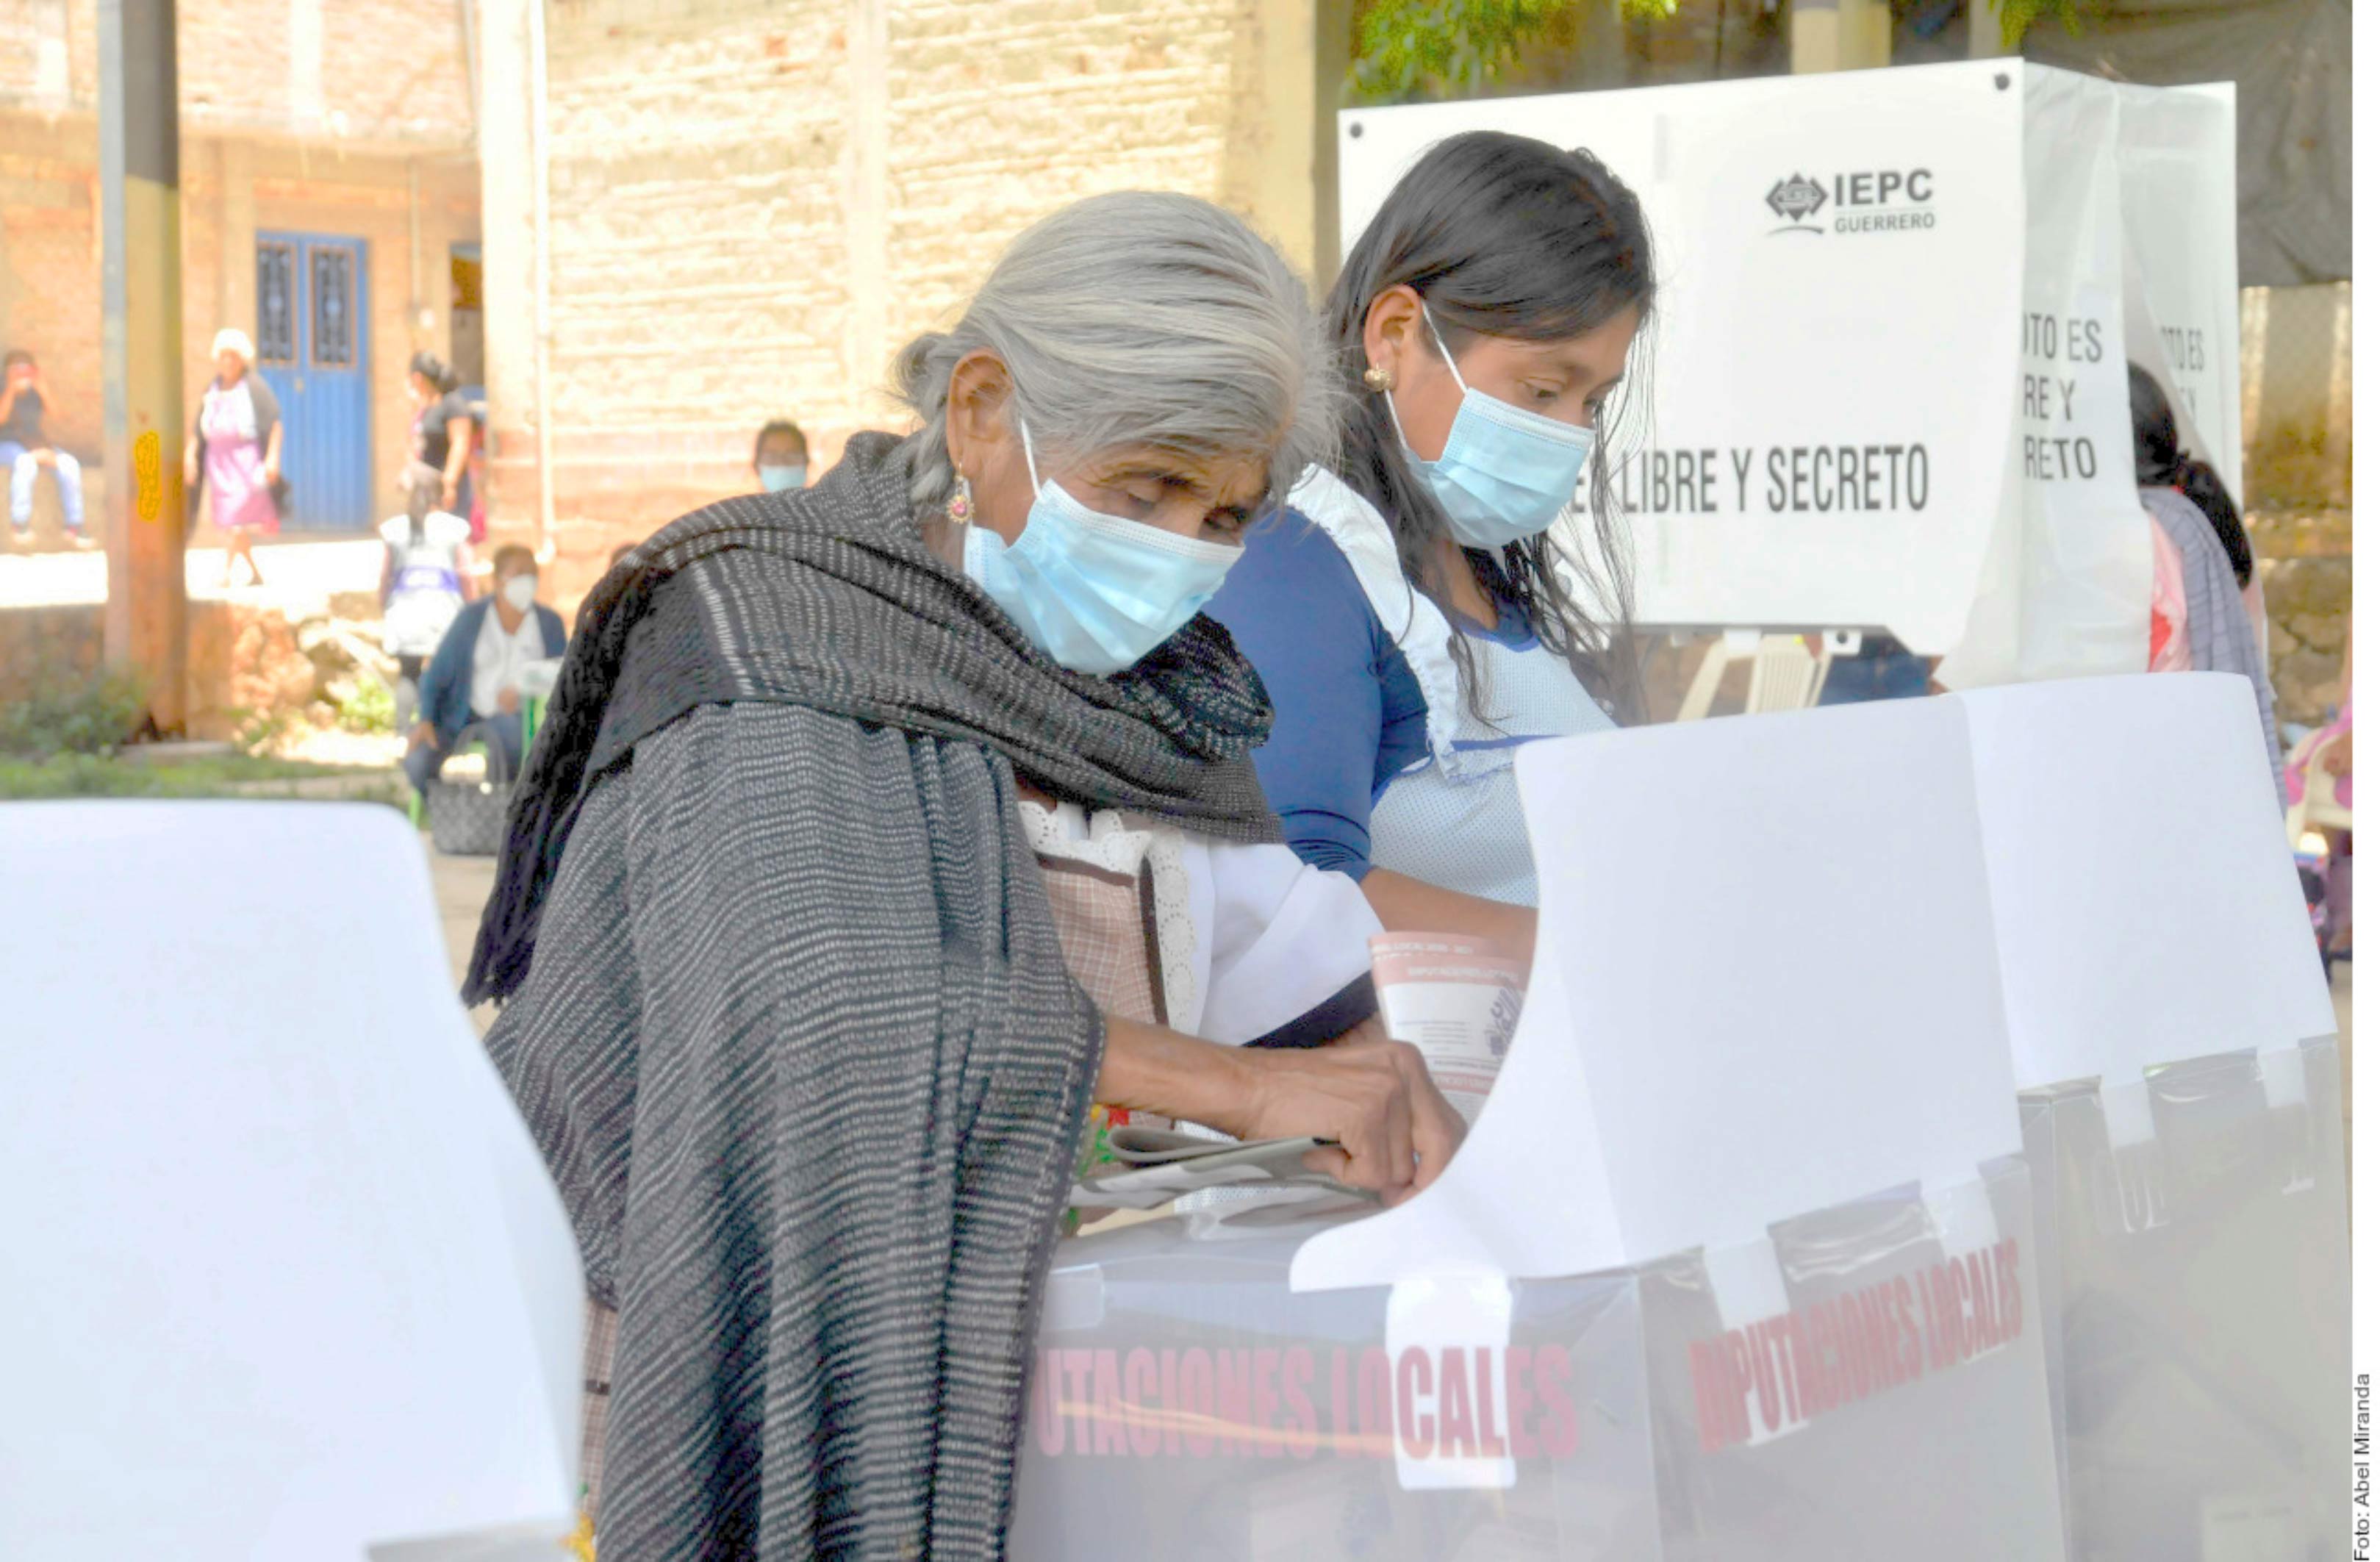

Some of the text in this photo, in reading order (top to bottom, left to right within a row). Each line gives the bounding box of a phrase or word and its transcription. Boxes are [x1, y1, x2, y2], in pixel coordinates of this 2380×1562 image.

[1835, 168, 1933, 207] IEPC
[1834, 212, 1936, 234] GUERRERO
[2068, 318, 2103, 363] ES
[2024, 373, 2076, 422] RE Y
[1621, 448, 1717, 514] LIBRE
[1731, 447, 1753, 512] Y
[1767, 443, 1930, 513] SECRETO
[2024, 434, 2098, 481] RETO
[1688, 1237, 2023, 1453] DIPUTACIONES LOCALES
[1332, 1344, 1578, 1460] LOCALES
